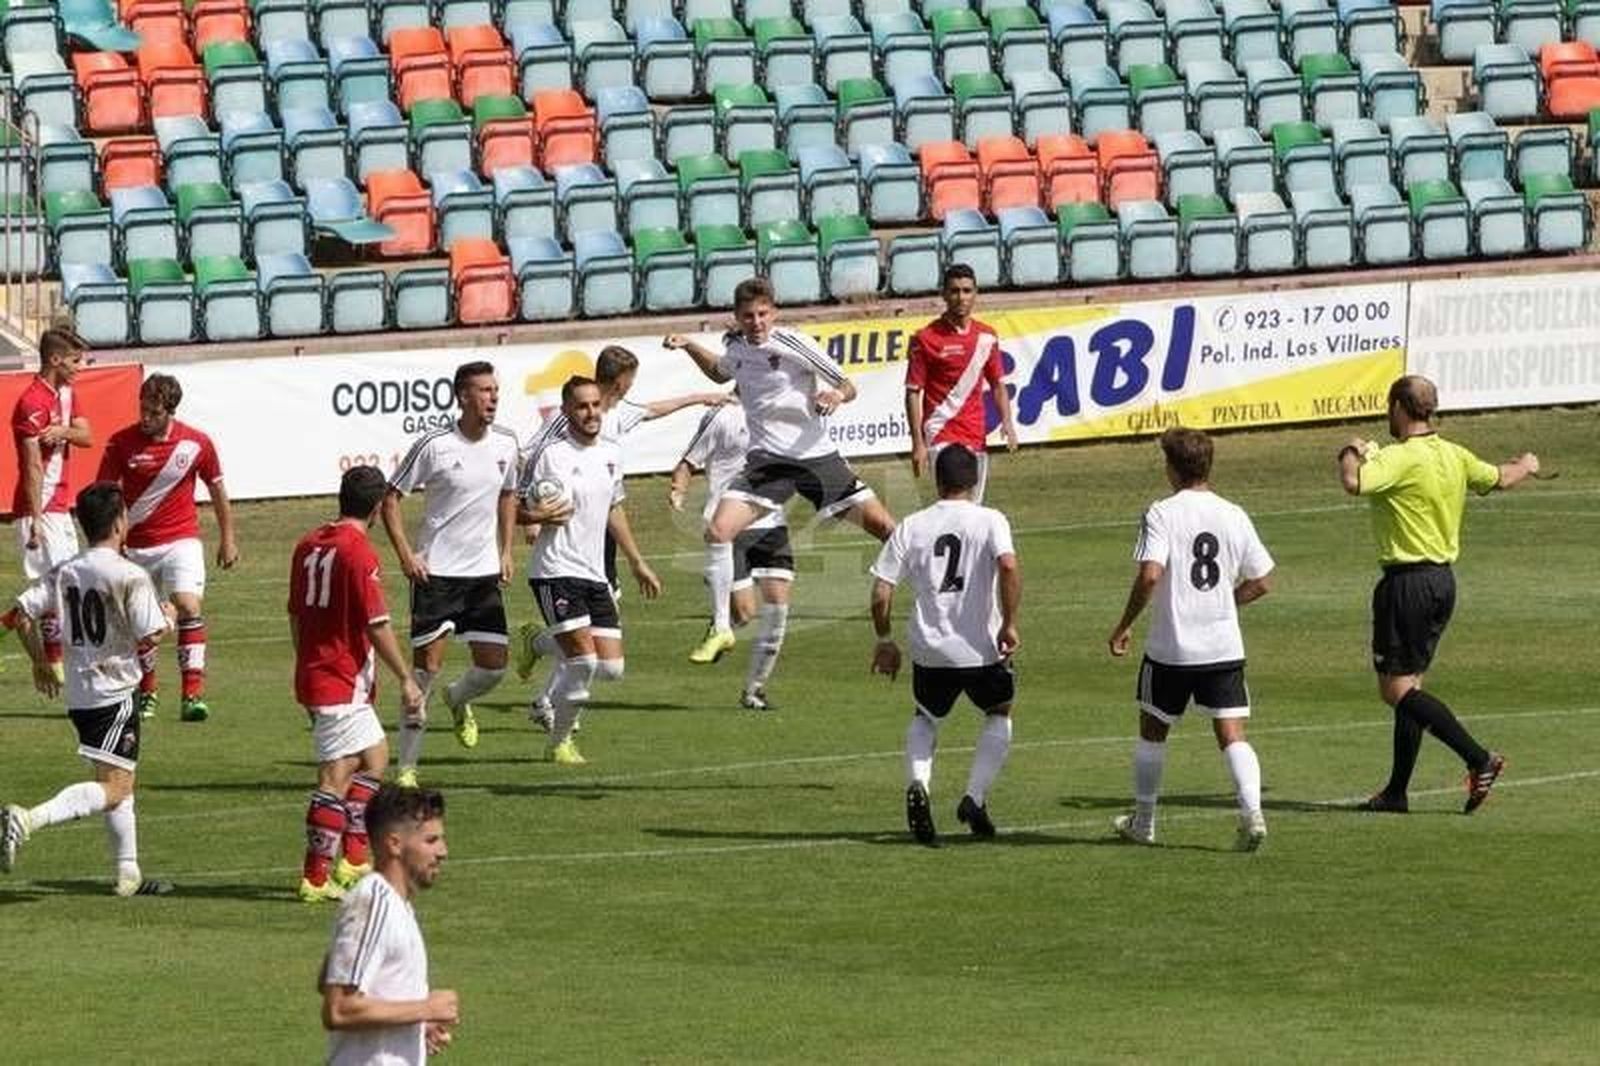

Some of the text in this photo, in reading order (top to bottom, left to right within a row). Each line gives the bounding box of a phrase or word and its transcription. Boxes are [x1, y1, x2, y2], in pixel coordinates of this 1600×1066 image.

[1244, 310, 1280, 330] 923
[1303, 307, 1325, 325] 17
[1333, 304, 1360, 324] 00
[1365, 301, 1390, 321] 00
[814, 330, 912, 365] ALLE
[1201, 333, 1401, 364] Pol. Ind. Los Villares
[1212, 399, 1282, 424] PINTURA
[1312, 392, 1388, 417] MECANIC
[302, 547, 336, 608] 11
[934, 533, 964, 593] 2
[1191, 531, 1220, 592] 8
[65, 585, 107, 647] 10
